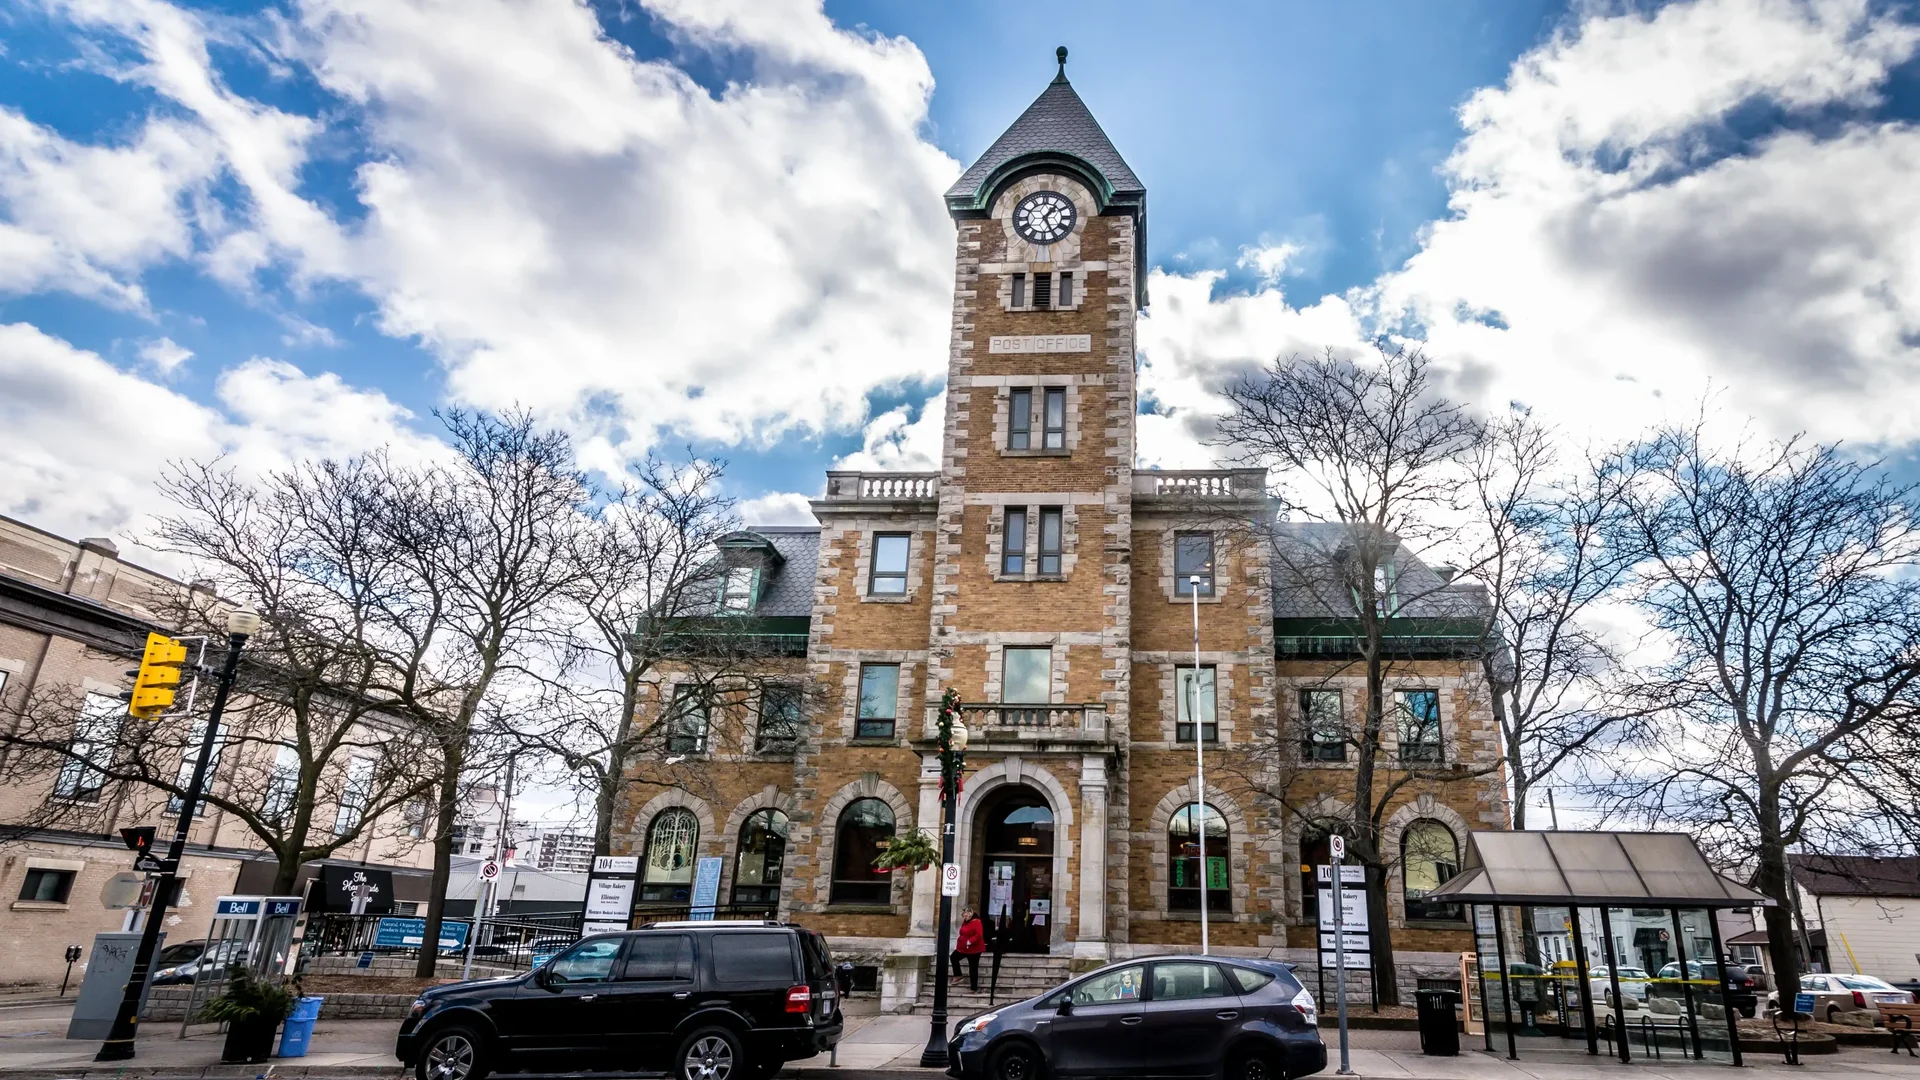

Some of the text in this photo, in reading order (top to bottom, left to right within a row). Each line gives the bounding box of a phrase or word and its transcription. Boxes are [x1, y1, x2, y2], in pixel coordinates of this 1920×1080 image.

[993, 338, 1088, 350] POST OFFICE
[599, 859, 613, 869] 104
[353, 871, 367, 882] The
[1213, 861, 1221, 887] BAKERY
[1322, 868, 1332, 878] 10
[229, 902, 249, 913] Bell
[274, 903, 291, 914] Bell
